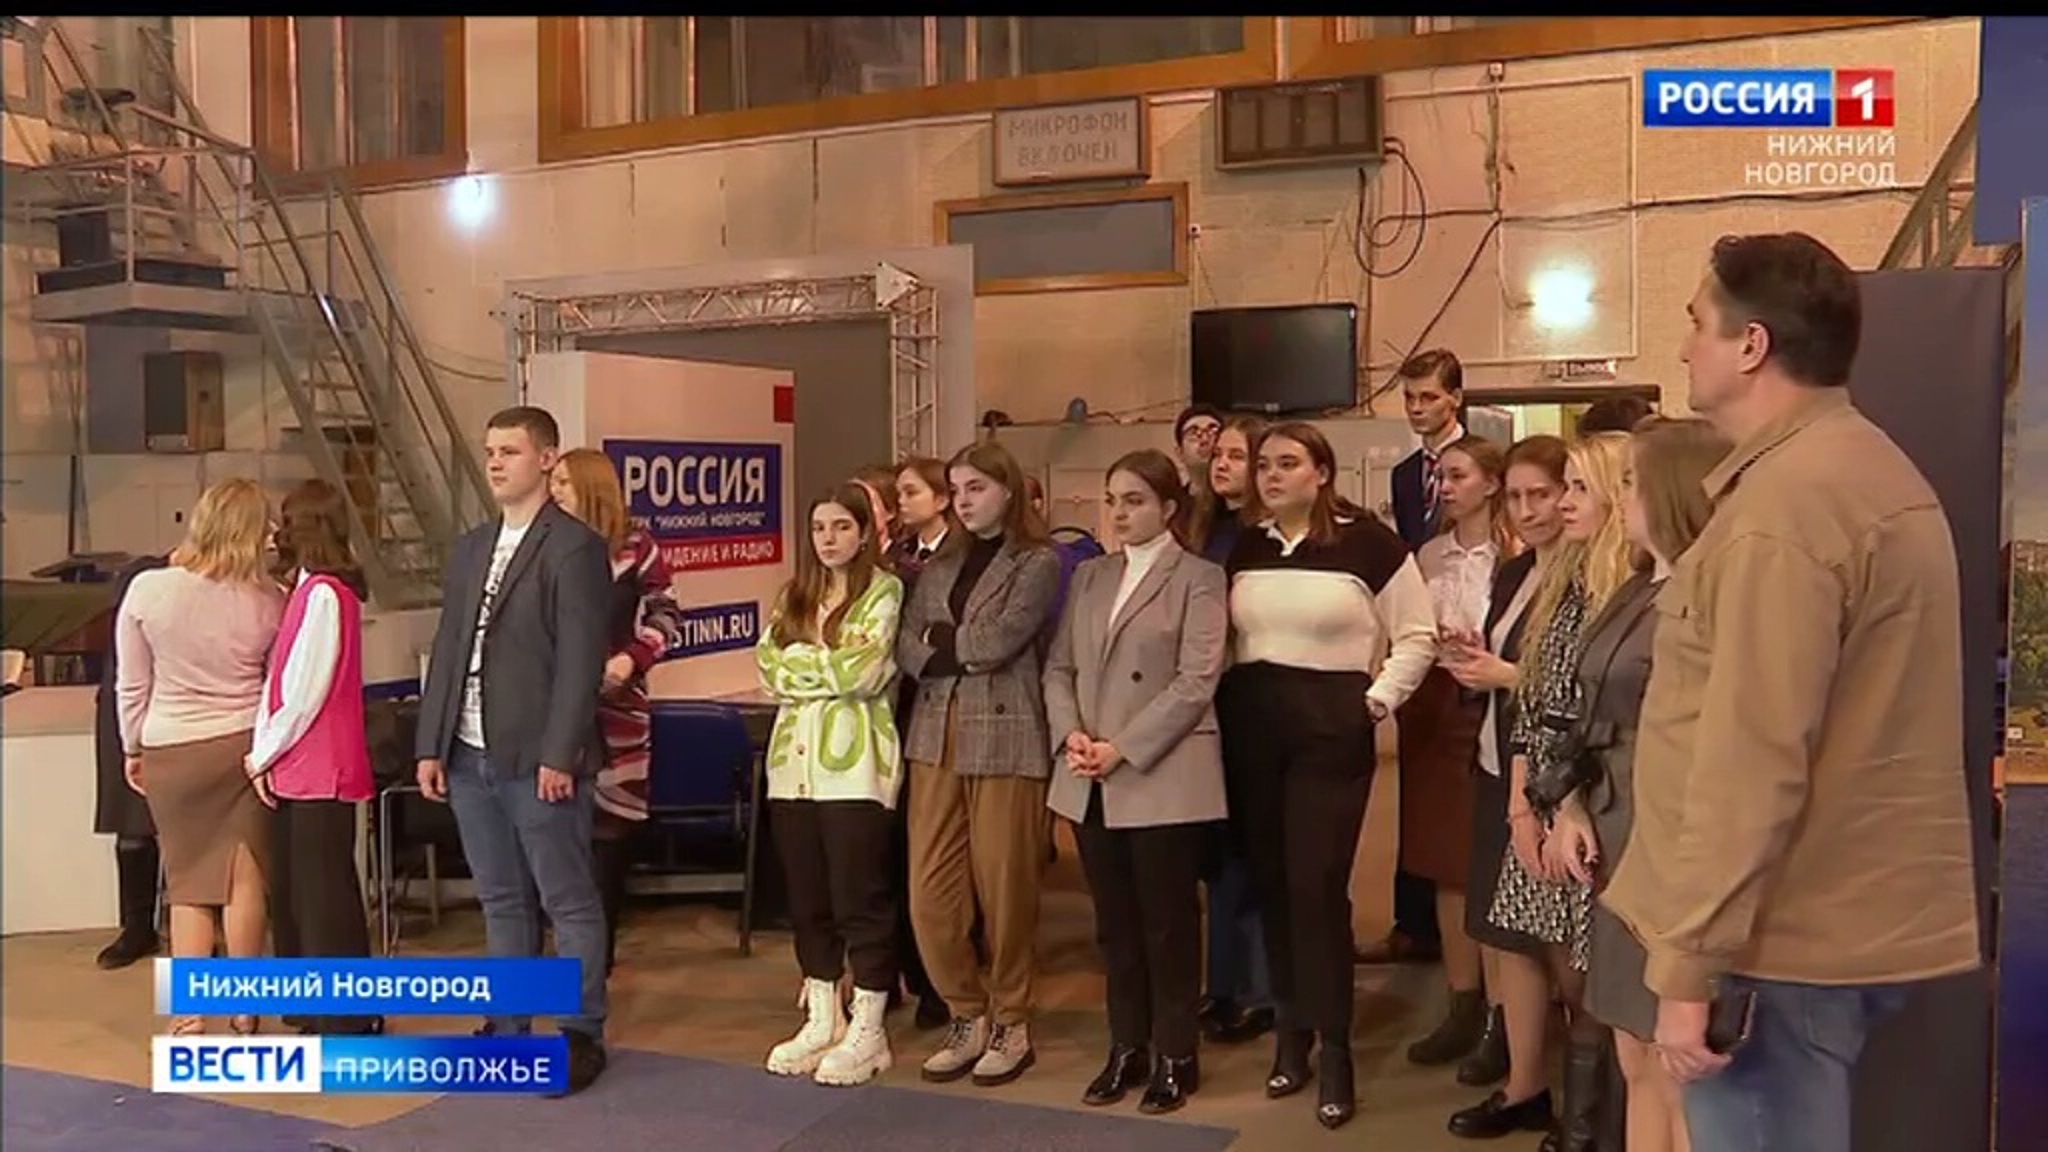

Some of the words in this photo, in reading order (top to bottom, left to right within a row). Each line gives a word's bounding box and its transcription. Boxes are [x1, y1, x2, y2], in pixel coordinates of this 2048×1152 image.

[1008, 111, 1128, 138] МИКРОФОН
[624, 455, 767, 507] РОССИЯ
[721, 546, 730, 560] И
[733, 540, 775, 561] РАДИО
